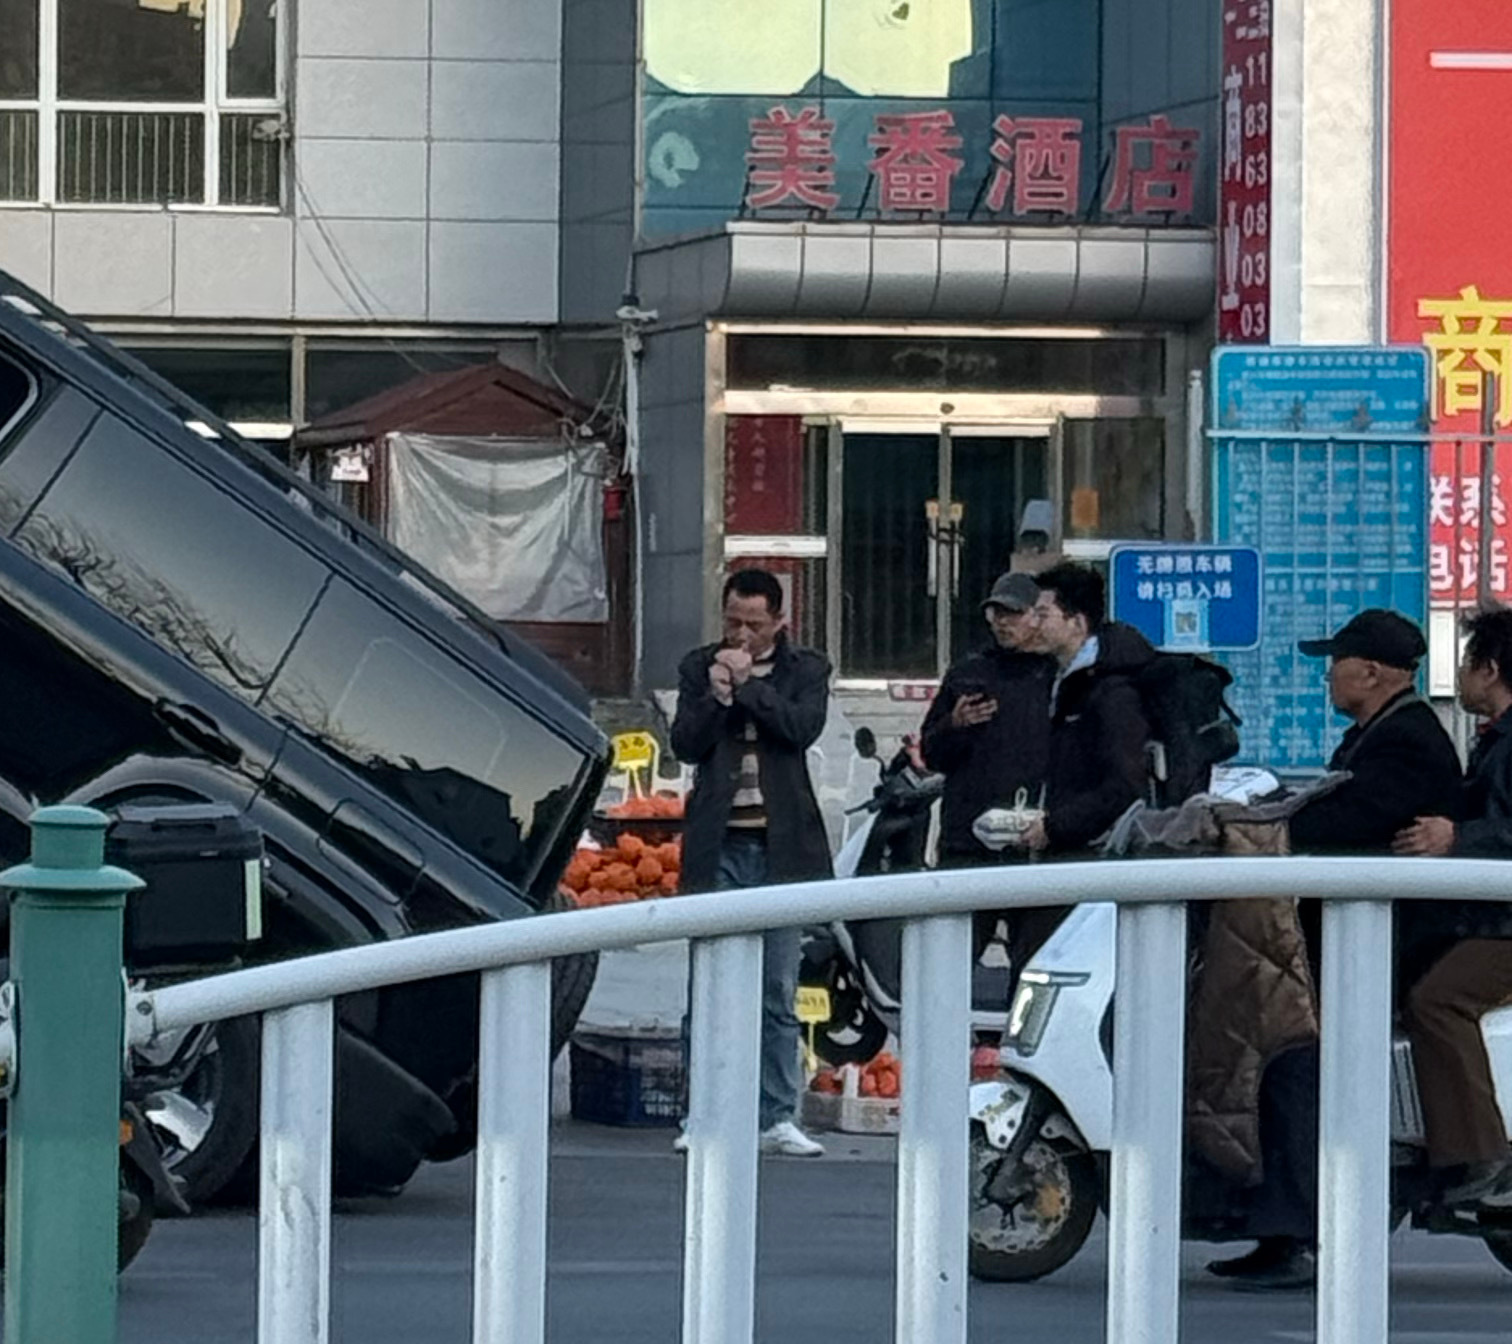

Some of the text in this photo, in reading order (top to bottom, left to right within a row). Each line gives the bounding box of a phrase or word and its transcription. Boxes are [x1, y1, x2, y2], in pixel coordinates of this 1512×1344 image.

[744, 106, 1199, 215] 美番酒店
[1221, 65, 1243, 344] 商业
[1418, 284, 1512, 427] 商
